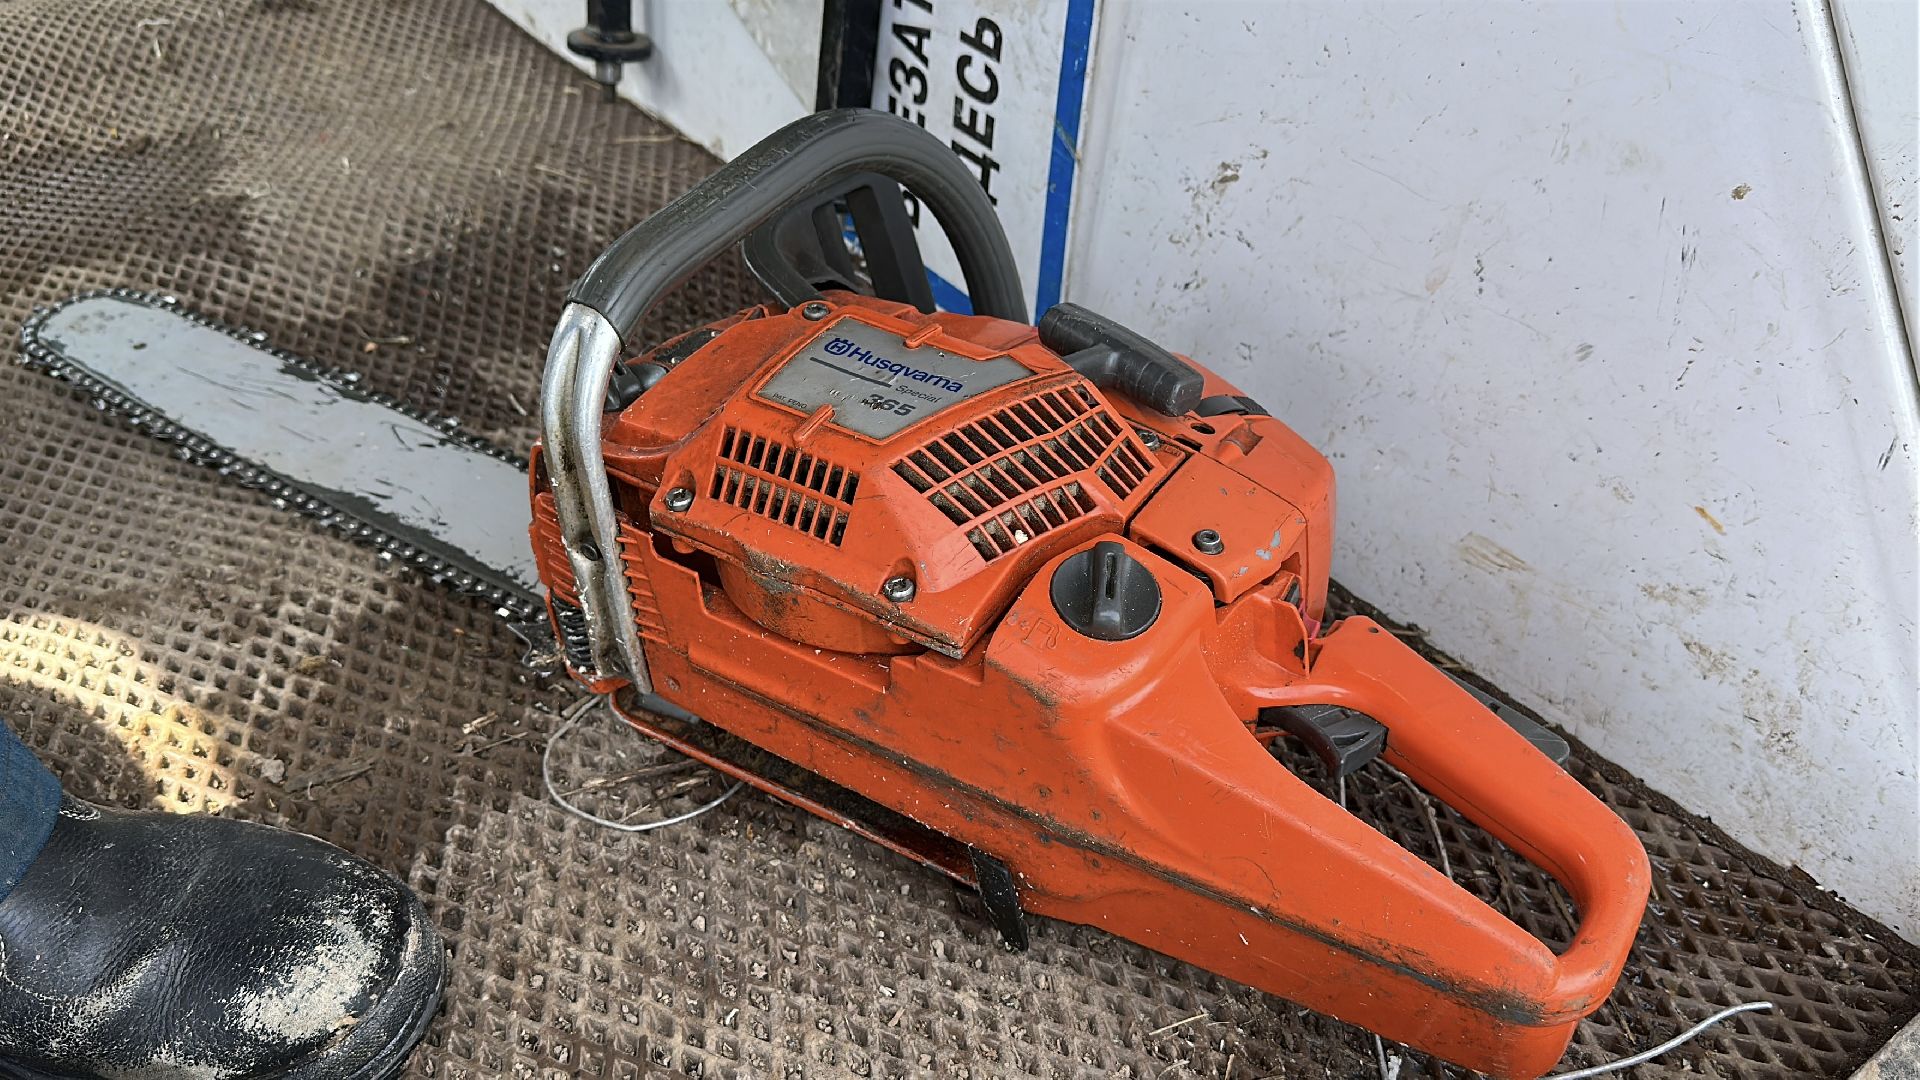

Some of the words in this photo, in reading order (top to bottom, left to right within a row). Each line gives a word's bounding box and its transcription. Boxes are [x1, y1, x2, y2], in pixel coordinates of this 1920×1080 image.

[951, 17, 1003, 206] ДЕСЬ
[847, 346, 963, 392] Husqvarna
[869, 394, 916, 416] 365
[895, 385, 942, 403] Special
